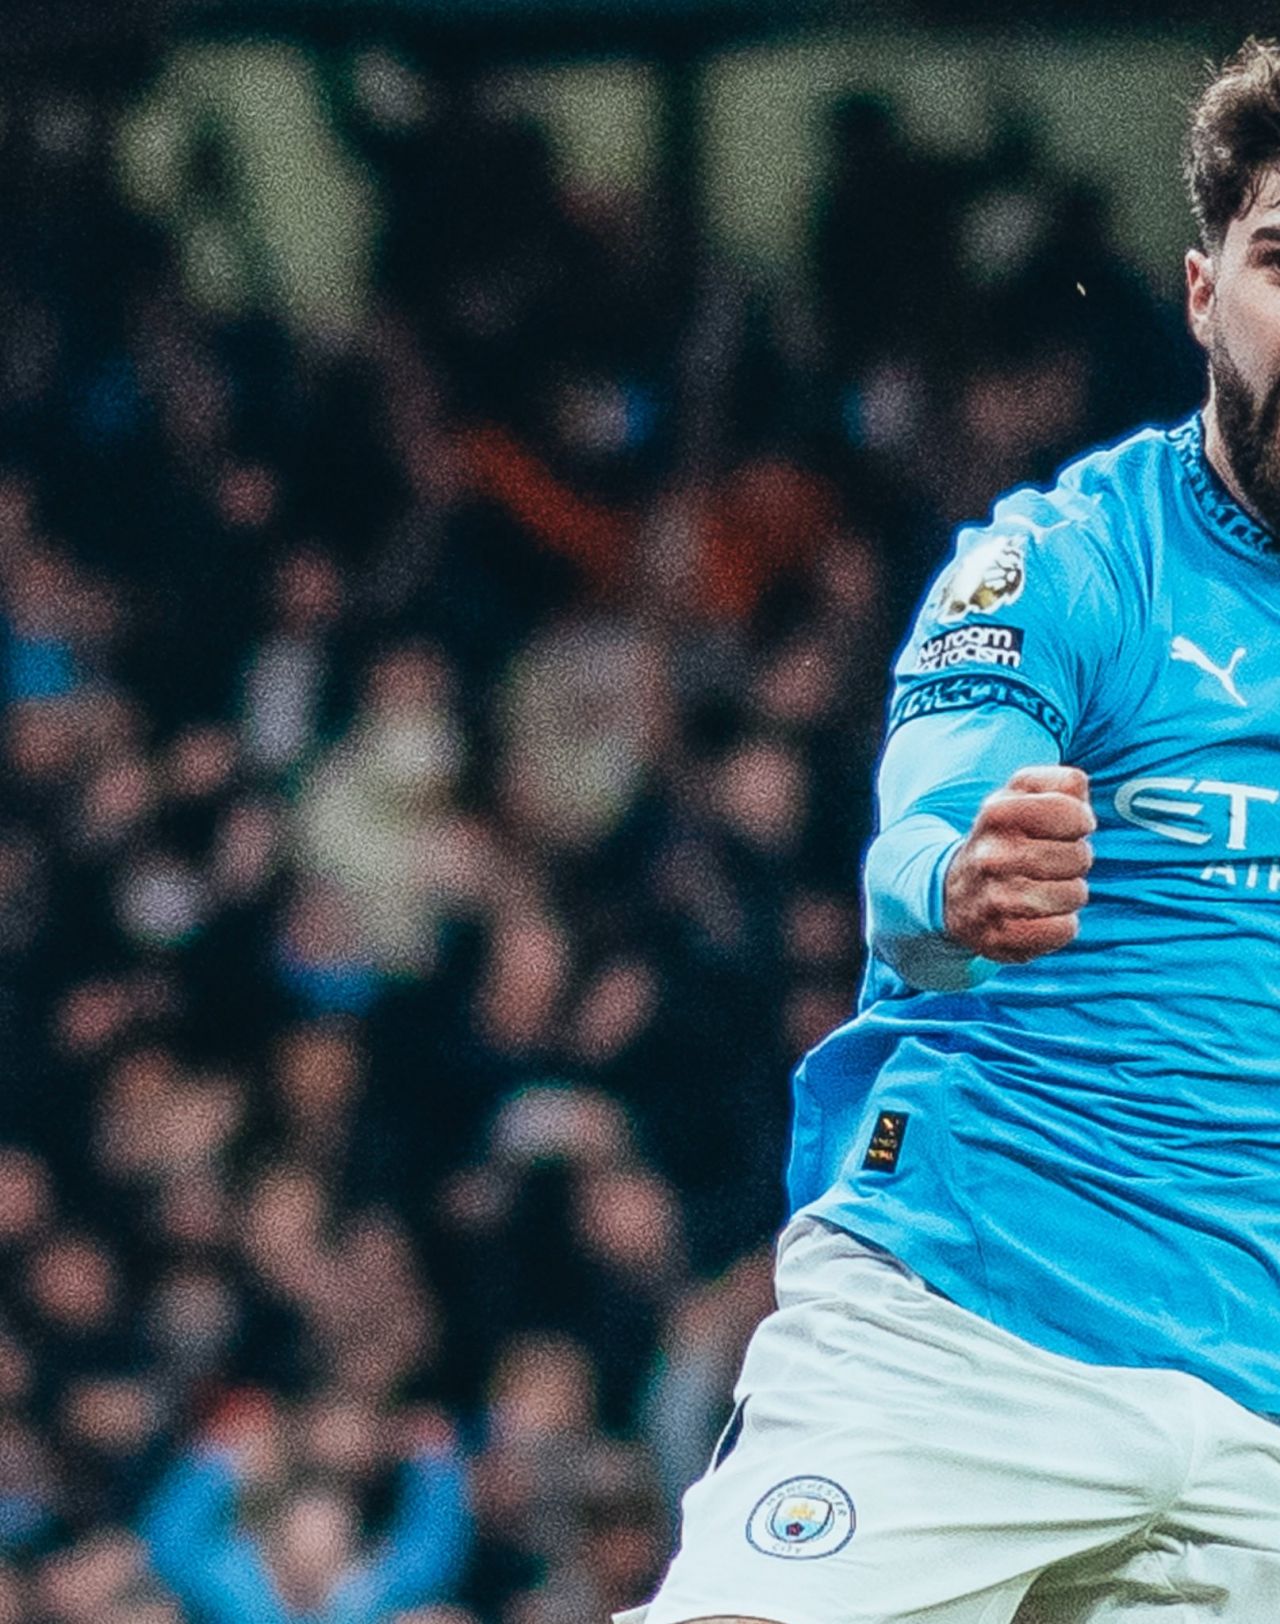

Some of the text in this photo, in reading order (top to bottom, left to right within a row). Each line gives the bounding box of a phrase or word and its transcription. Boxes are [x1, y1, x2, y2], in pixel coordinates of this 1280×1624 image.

[919, 627, 1012, 661] No room
[942, 645, 1021, 669] racism
